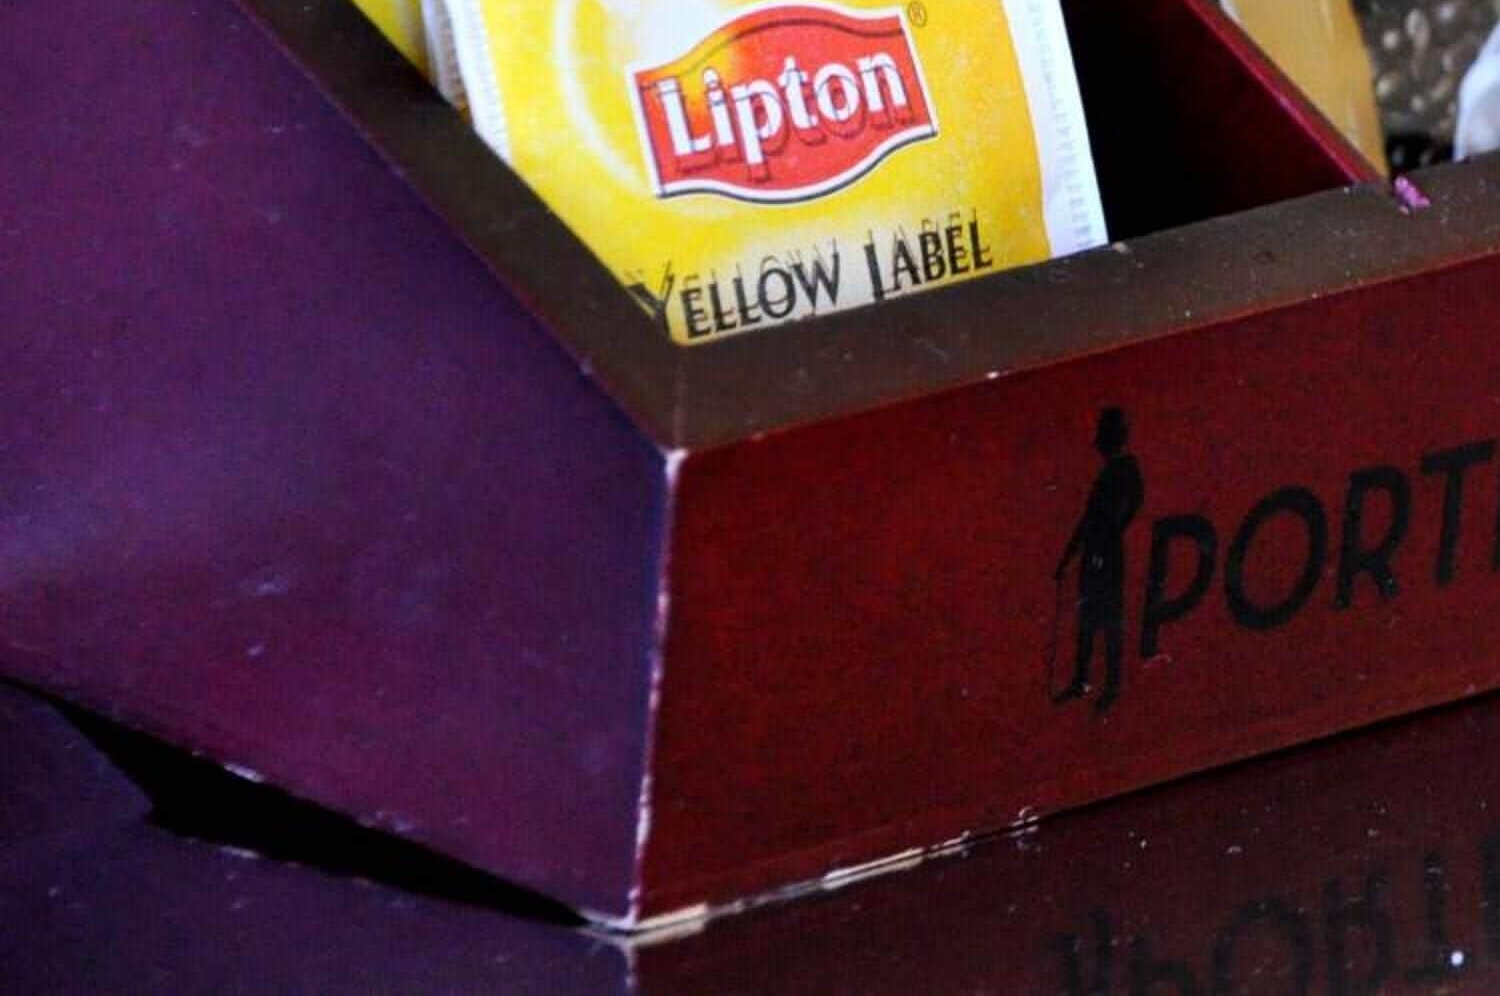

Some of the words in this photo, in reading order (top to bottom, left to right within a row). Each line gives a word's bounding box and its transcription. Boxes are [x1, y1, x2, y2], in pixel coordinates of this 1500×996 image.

[655, 50, 912, 170] Lipton
[629, 241, 841, 340] YELLOW
[863, 212, 995, 302] LABEL
